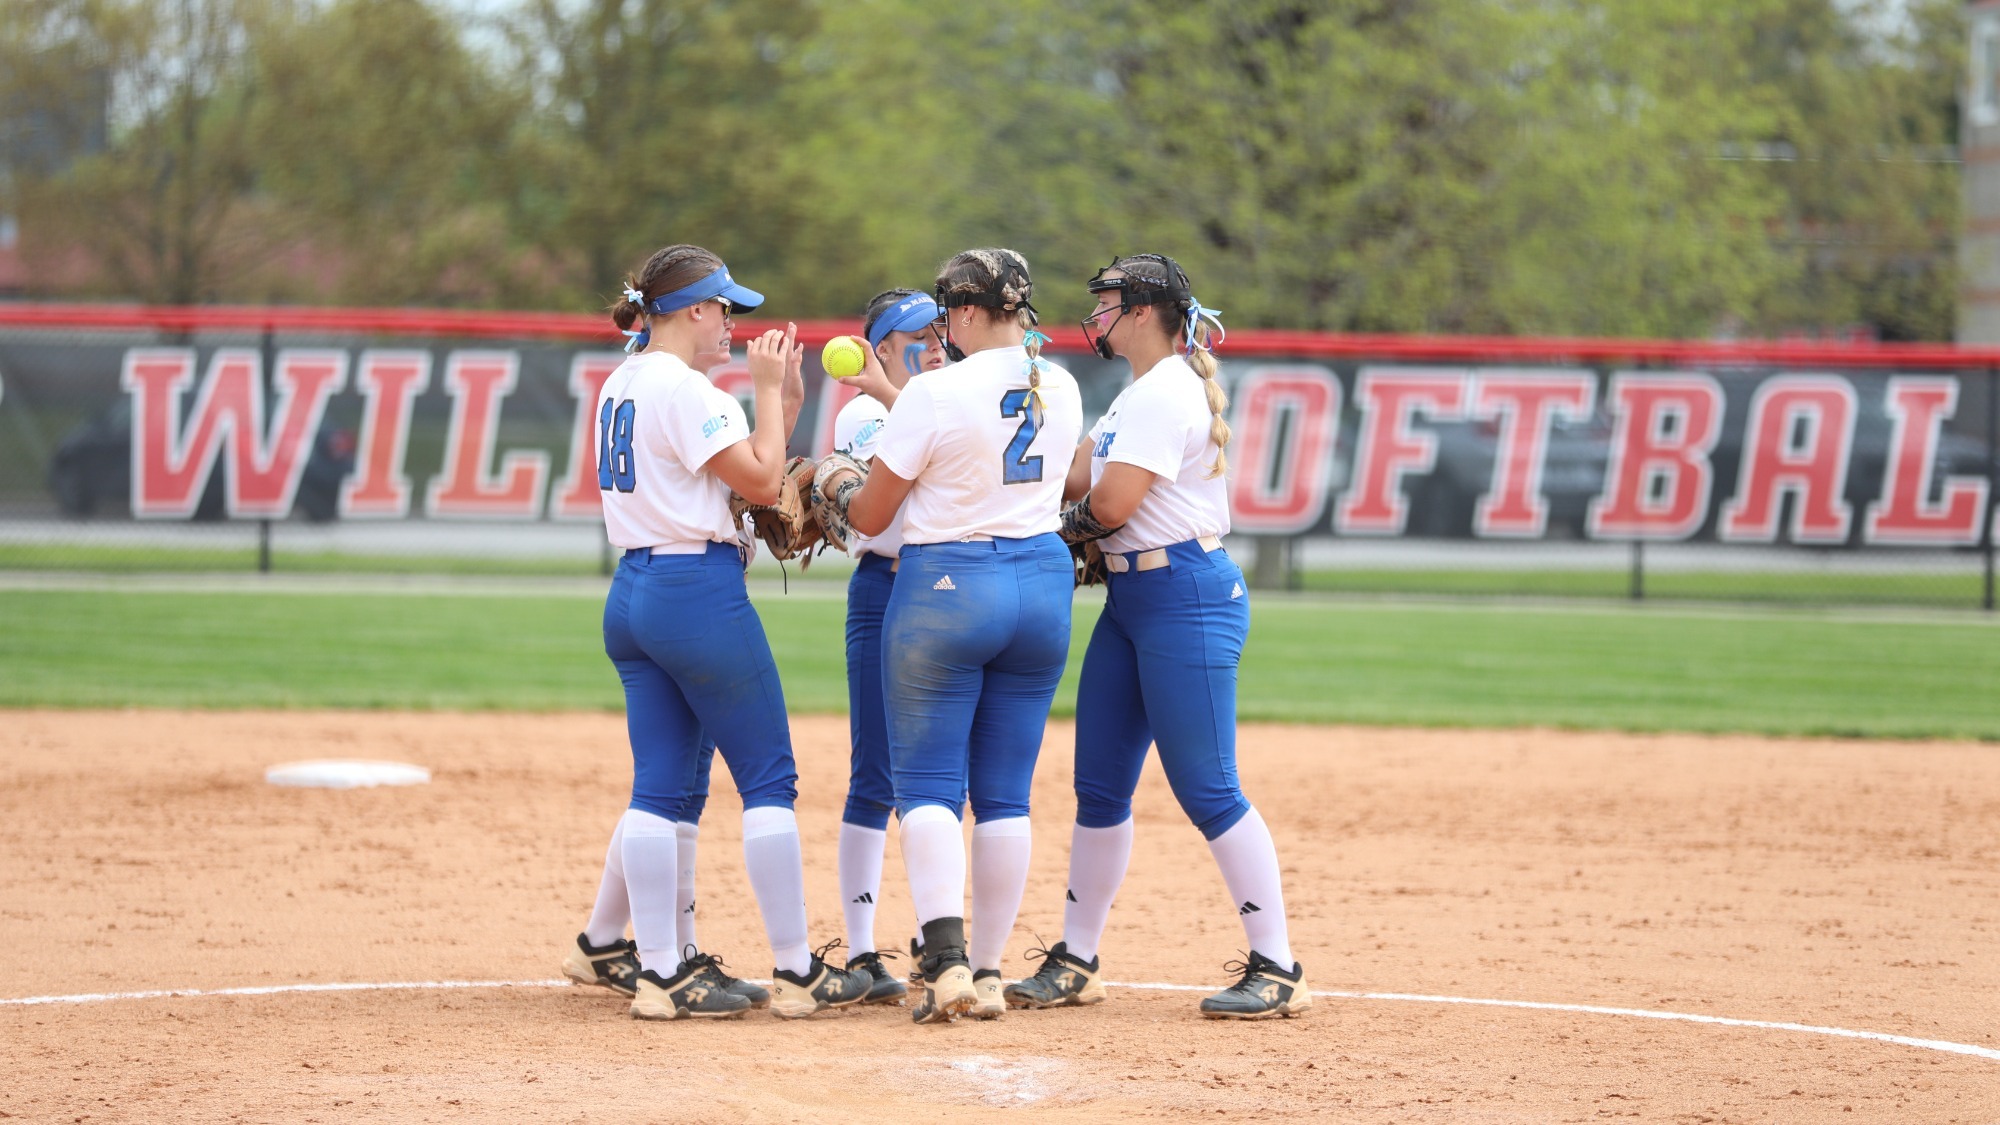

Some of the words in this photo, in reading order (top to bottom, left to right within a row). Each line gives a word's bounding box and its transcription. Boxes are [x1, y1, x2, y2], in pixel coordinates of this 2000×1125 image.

[599, 397, 636, 493] 18
[1000, 388, 1044, 485] 2
[933, 583, 956, 591] adidas
